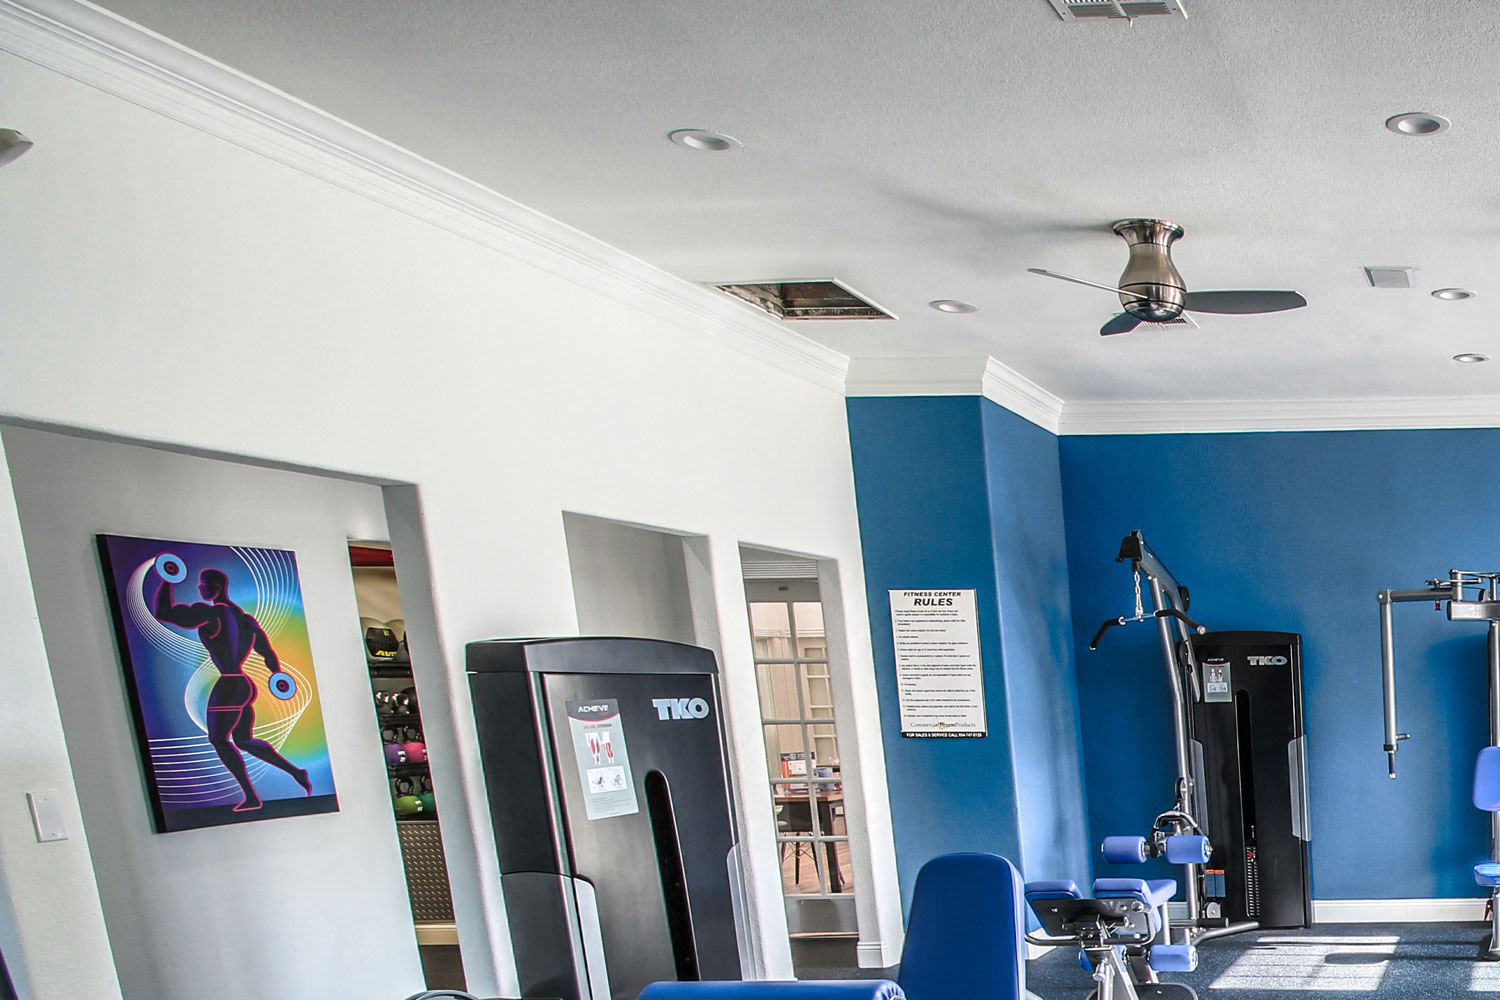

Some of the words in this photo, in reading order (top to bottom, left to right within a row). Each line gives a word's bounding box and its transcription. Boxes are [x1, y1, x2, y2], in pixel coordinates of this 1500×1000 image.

[913, 598, 953, 606] RULES
[1246, 655, 1288, 666] TKO
[651, 697, 710, 721] TKO
